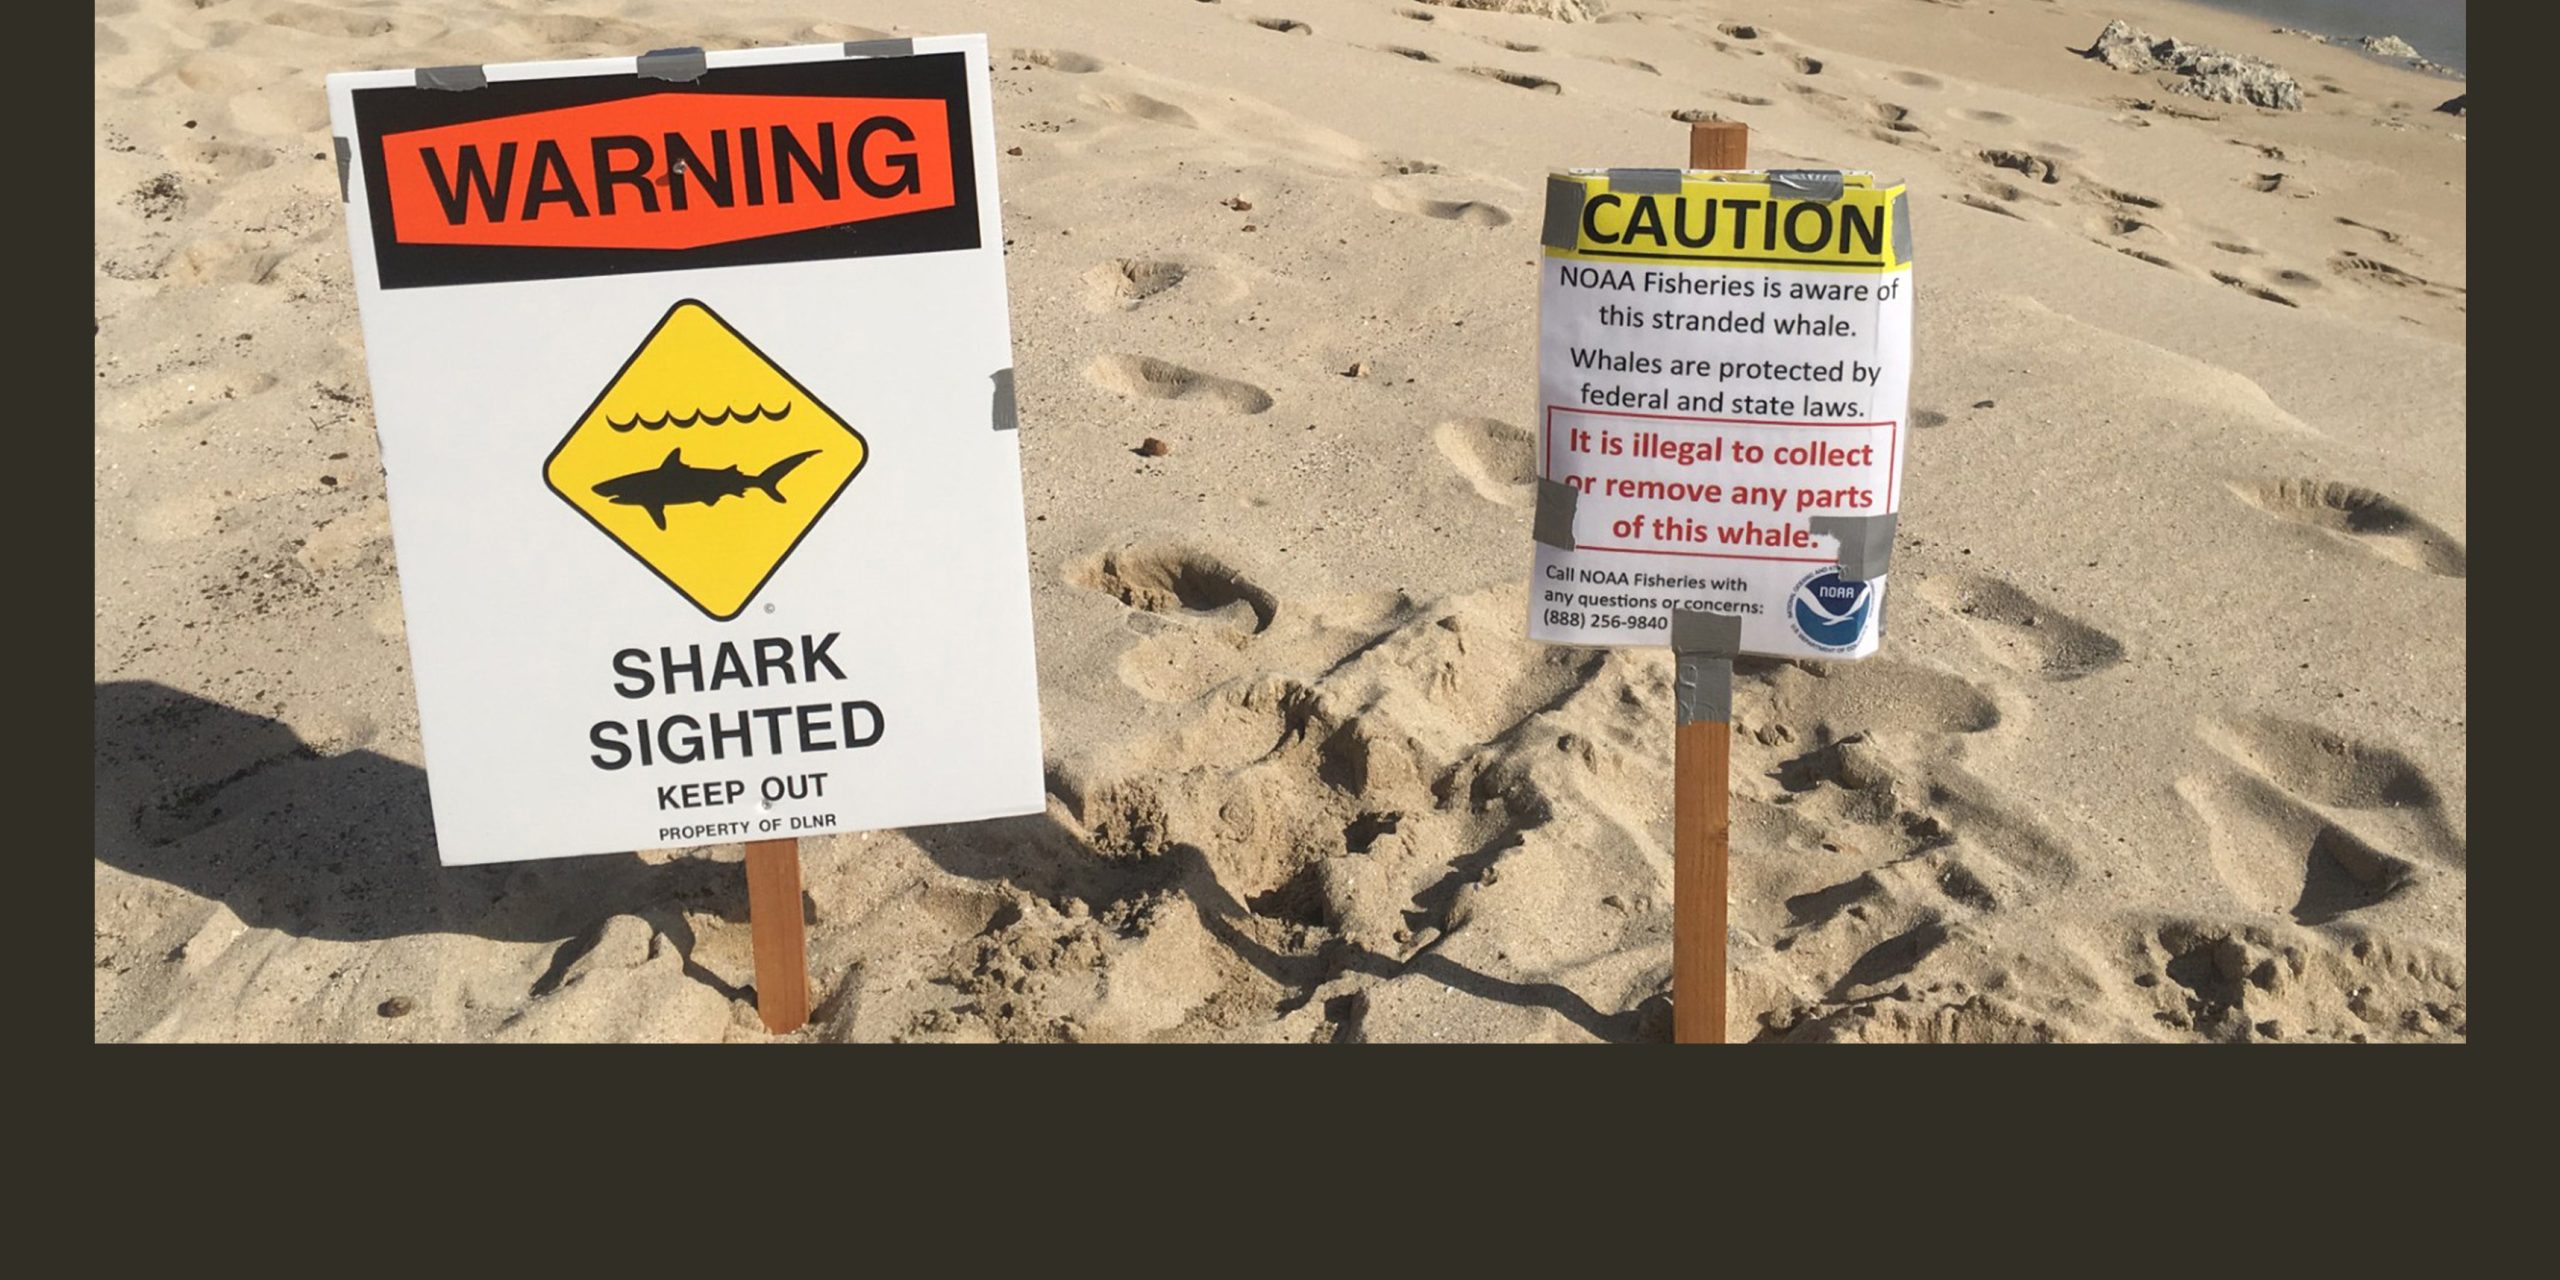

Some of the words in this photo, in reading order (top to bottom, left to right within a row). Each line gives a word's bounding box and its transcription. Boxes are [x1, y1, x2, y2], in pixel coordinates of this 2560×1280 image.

[419, 116, 921, 226] WARNING
[1582, 194, 1885, 255] CAUTION
[1561, 266, 1635, 291] NOAA
[1644, 272, 1754, 297] Fisheries
[1764, 277, 1781, 298] is
[1790, 283, 1868, 301] aware
[1877, 278, 1899, 301] of
[1599, 305, 1643, 328] this
[1652, 310, 1764, 333] stranded
[1774, 313, 1855, 336] whale.
[1570, 347, 1662, 374] Whales
[1671, 360, 1710, 376] are
[1719, 360, 1843, 383] protected
[1853, 361, 1881, 386] by
[1581, 383, 1668, 409] federal
[1677, 392, 1723, 412] and
[1732, 396, 1794, 416] state
[1804, 395, 1864, 418] laws.
[1571, 428, 1590, 453] It
[1602, 430, 1622, 455] is
[1633, 433, 1722, 465] illegal
[1732, 441, 1763, 463] to
[1774, 441, 1873, 466] collect
[1564, 475, 1596, 494] or
[1606, 479, 1721, 503] remove
[1732, 486, 1787, 511] any
[1797, 486, 1872, 513] parts
[1613, 515, 1645, 538] of
[1653, 517, 1707, 542] this
[1717, 521, 1819, 549] whale.
[1546, 565, 1574, 581] Call
[1580, 570, 1629, 585] NOAA
[1634, 573, 1706, 589] Fisheries
[1711, 578, 1747, 592] with
[1819, 585, 1855, 599] NOAA
[1544, 608, 1585, 629] (888)
[1591, 614, 1668, 630] 256-9840
[1545, 590, 1573, 606] any
[1578, 594, 1657, 608] questions
[1662, 599, 1679, 609] or
[1684, 599, 1764, 614] concerns:
[613, 633, 847, 699] SHARK
[590, 701, 884, 770] SIGHTED
[658, 781, 744, 810] KEEP
[760, 773, 828, 802] OUT
[660, 821, 749, 840] PROPERTY
[759, 819, 781, 832] OF
[790, 814, 836, 829] DLNR
